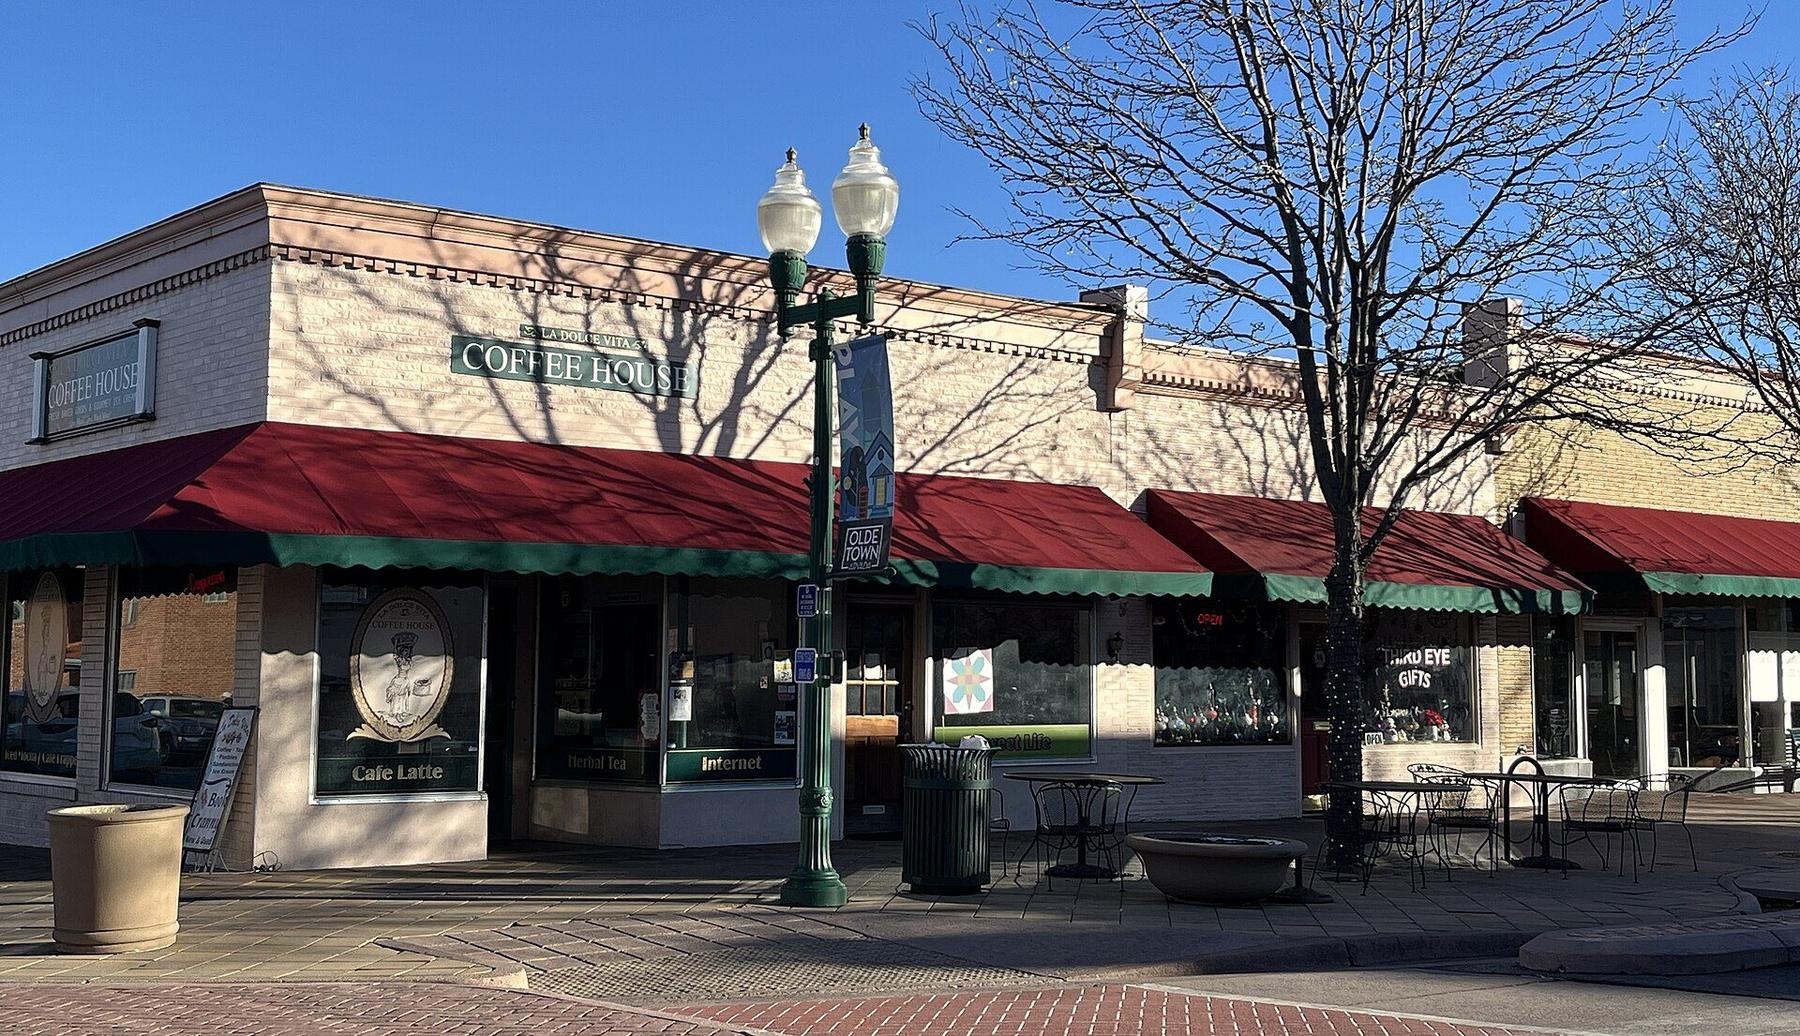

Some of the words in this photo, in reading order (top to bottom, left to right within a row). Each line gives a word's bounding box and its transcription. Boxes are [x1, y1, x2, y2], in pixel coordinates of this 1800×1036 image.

[541, 327, 557, 339] LA
[560, 330, 601, 345] DOLCE
[603, 335, 631, 349] VITA
[462, 342, 583, 382] COFFEE
[590, 356, 692, 393] HOUSE
[48, 375, 93, 409] COFFEE
[95, 362, 139, 397] HOUSE
[849, 529, 880, 545] OLDE
[846, 545, 879, 561] TOWN
[372, 621, 406, 629] COFFEE
[407, 621, 435, 630] HOUSE
[1197, 613, 1223, 625] OPEN
[1383, 648, 1422, 665] THIRD
[1424, 648, 1451, 666] EYE
[1398, 669, 1432, 688] GIFTS
[1023, 732, 1053, 751] Life
[1366, 733, 1383, 745] OPEN
[568, 754, 605, 769] Herbal
[607, 756, 627, 770] Tea
[701, 755, 763, 772] Internet
[352, 764, 394, 781] Cafe
[397, 764, 444, 780] Latte
